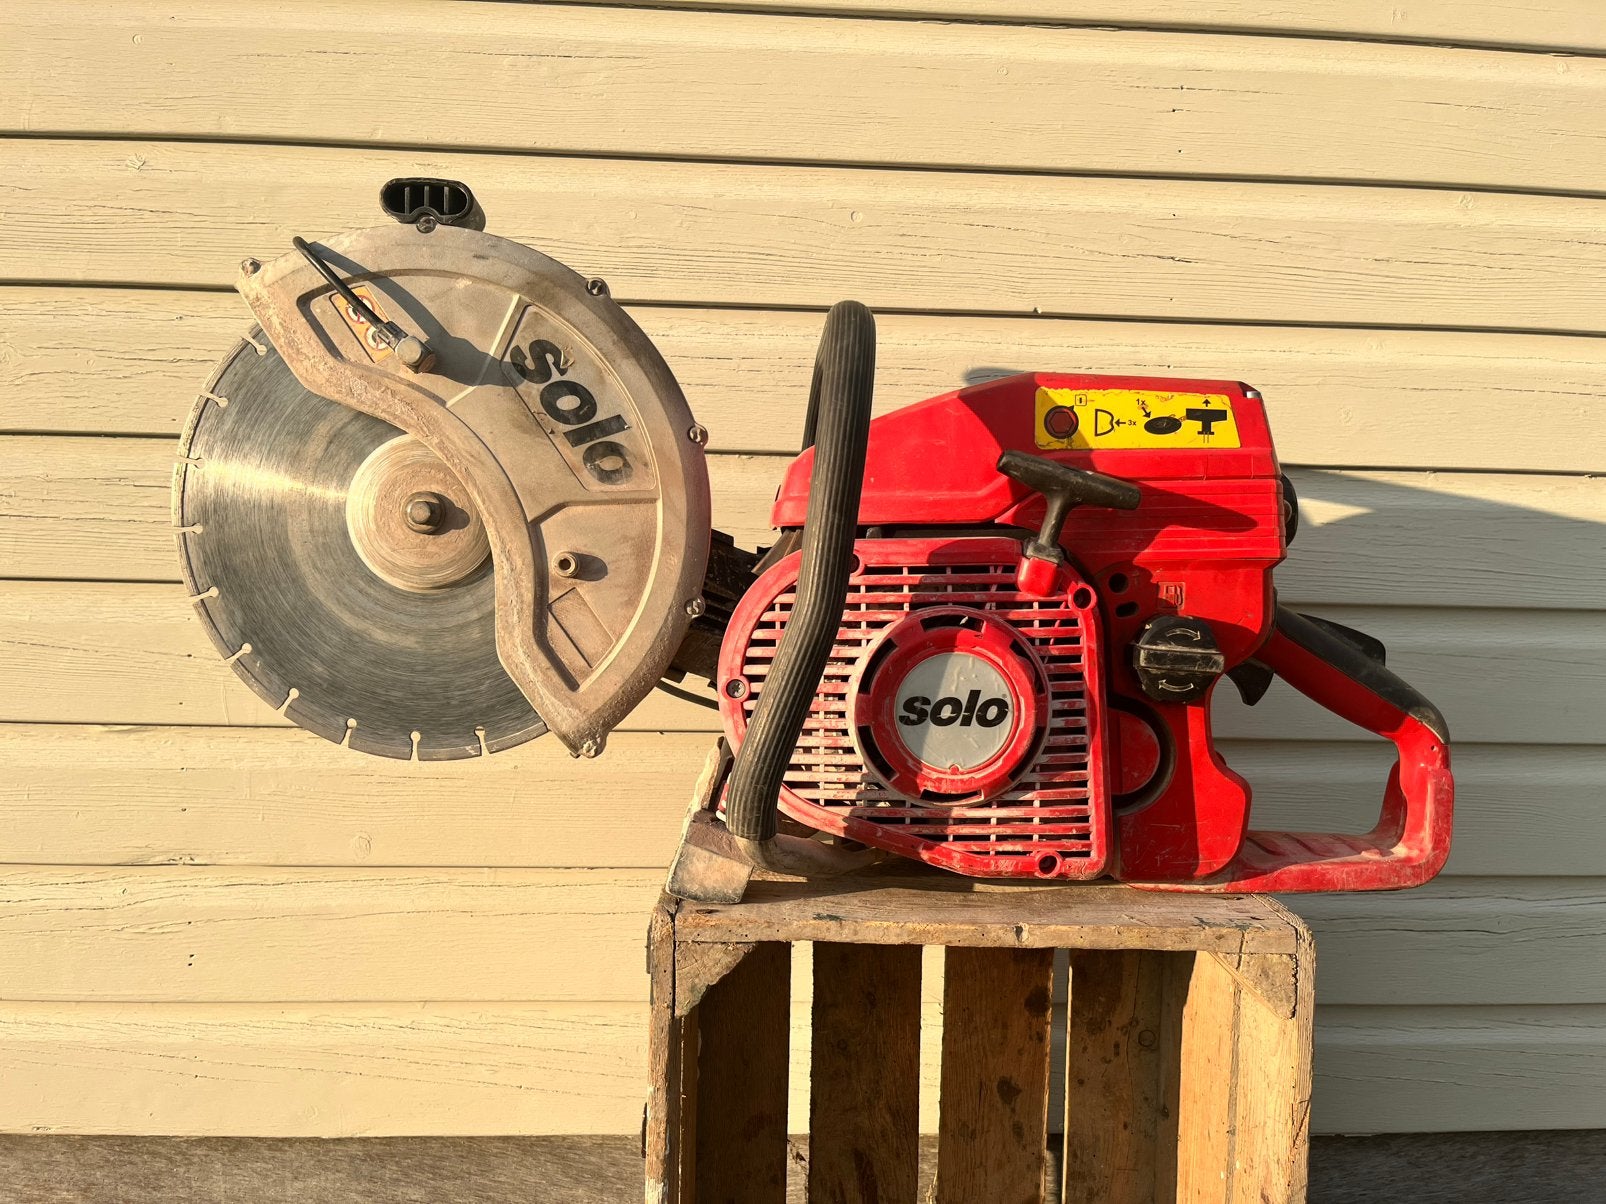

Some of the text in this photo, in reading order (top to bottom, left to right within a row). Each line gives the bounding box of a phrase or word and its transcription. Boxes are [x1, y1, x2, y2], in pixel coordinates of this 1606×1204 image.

[510, 339, 634, 485] solo
[1136, 398, 1146, 406] 1x
[898, 690, 1009, 728] solo
